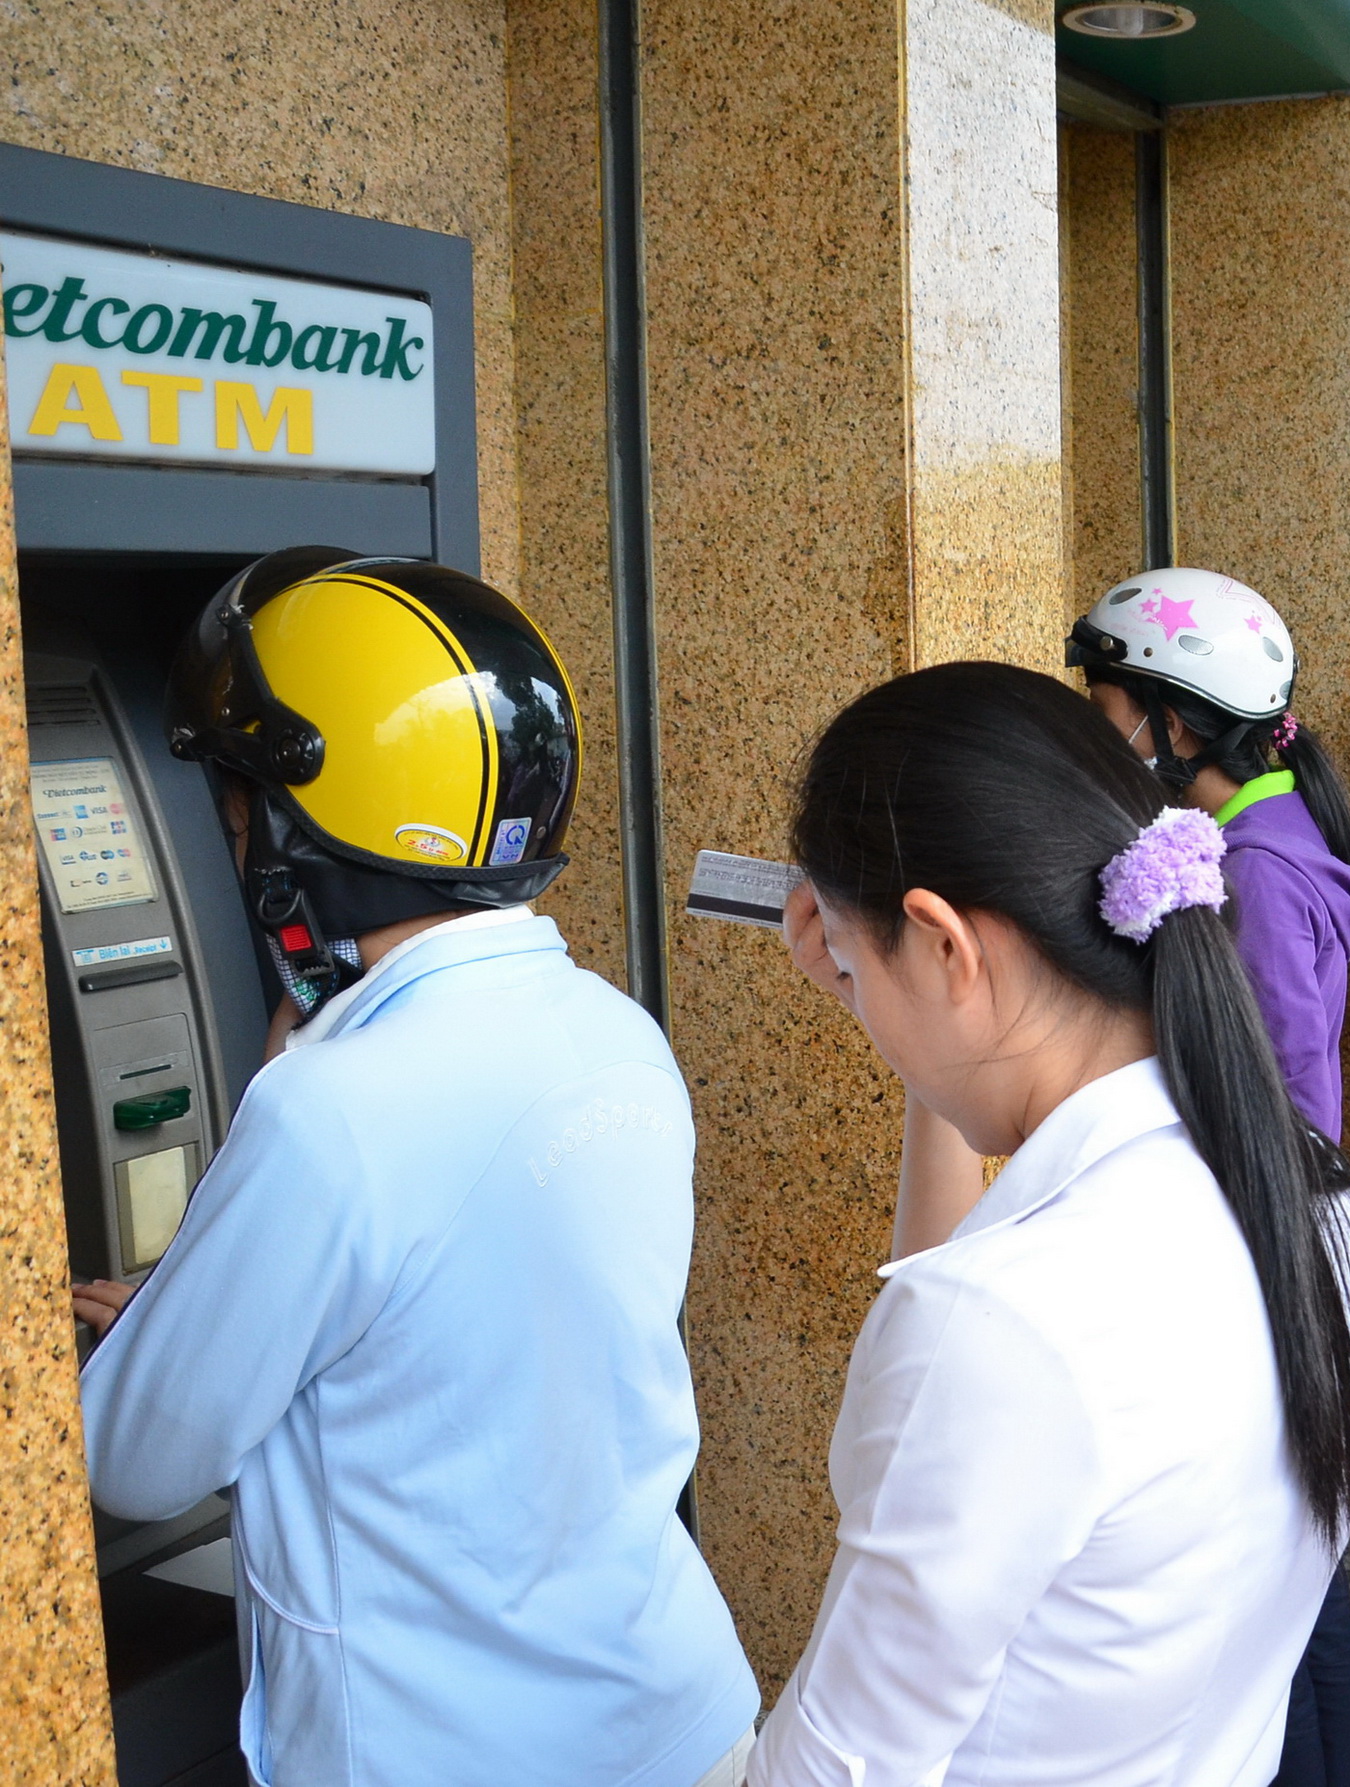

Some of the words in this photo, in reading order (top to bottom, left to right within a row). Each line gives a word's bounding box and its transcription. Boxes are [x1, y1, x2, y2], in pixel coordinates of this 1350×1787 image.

[1, 276, 424, 382] etcombank
[28, 362, 314, 455] ATM
[91, 806, 108, 815] VISA
